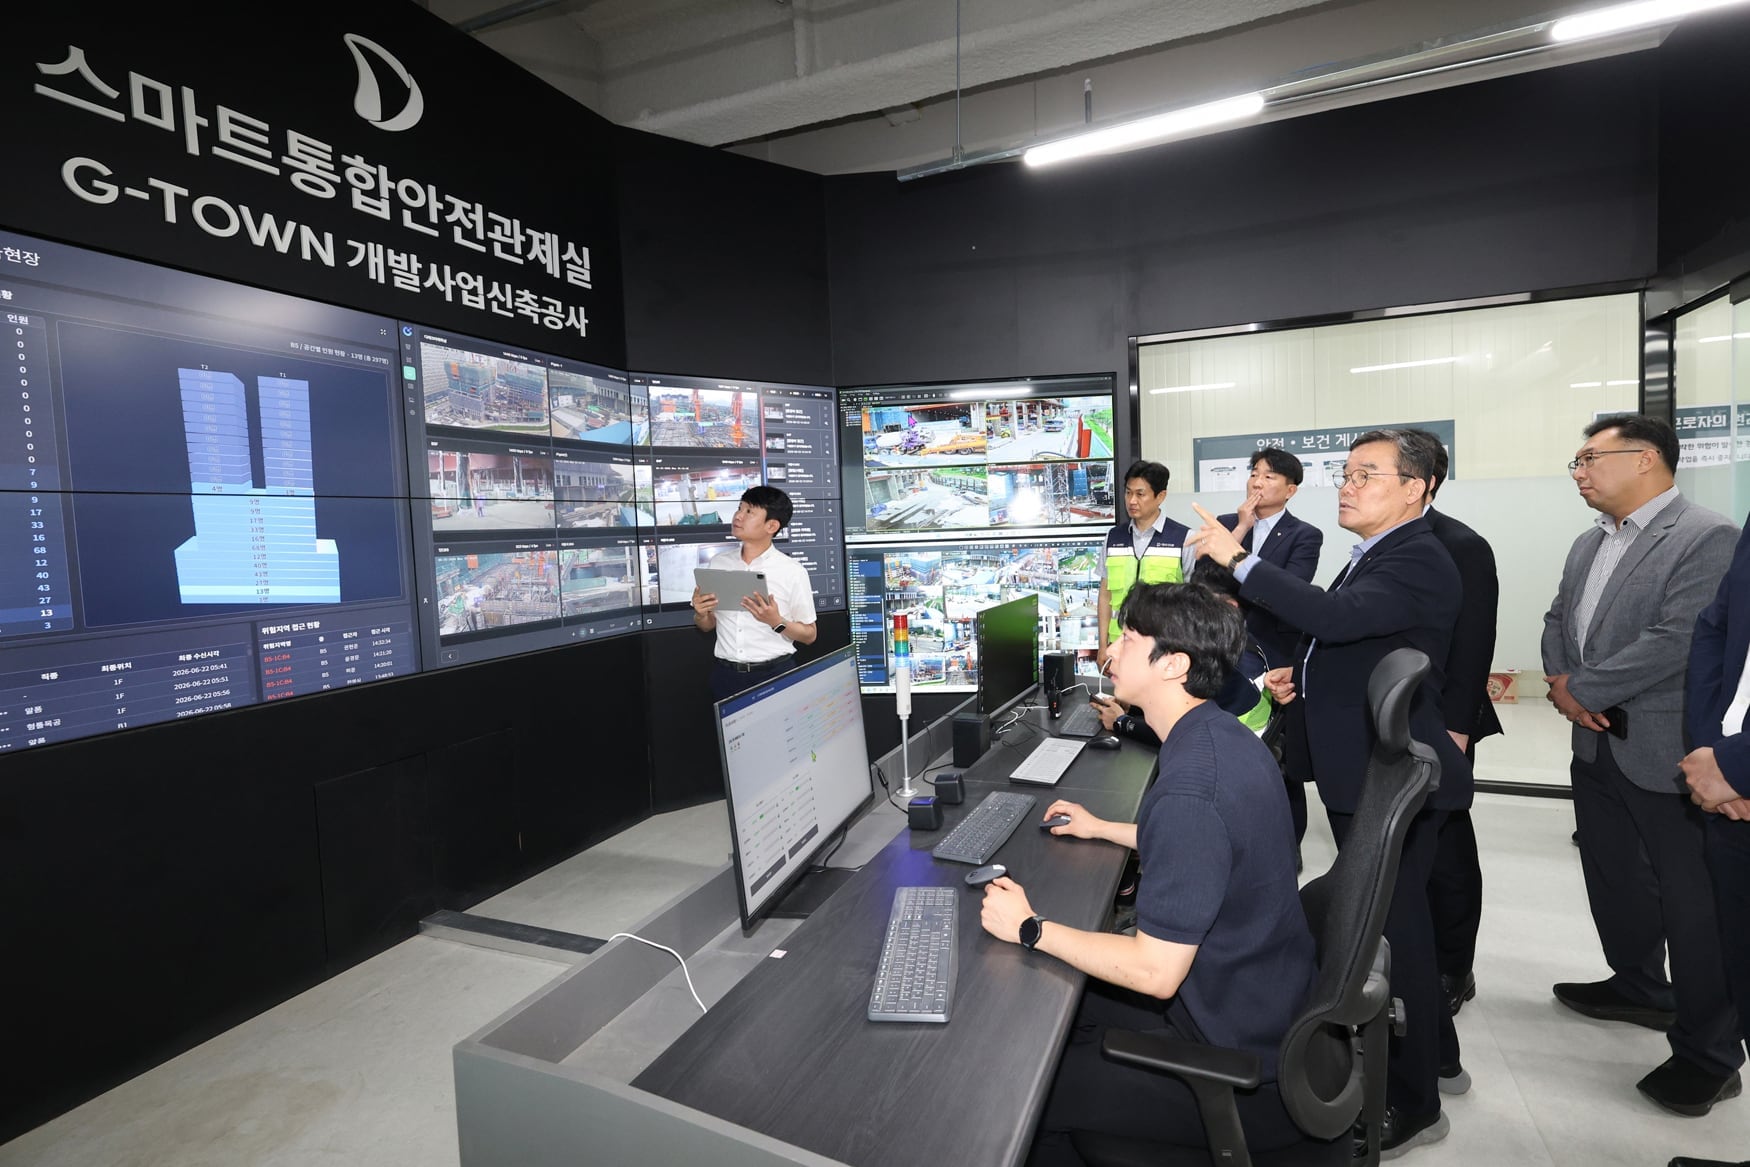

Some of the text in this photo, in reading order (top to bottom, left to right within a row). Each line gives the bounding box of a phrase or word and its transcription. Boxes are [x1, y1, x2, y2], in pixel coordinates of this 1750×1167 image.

[34, 45, 592, 289] 스마트통합안전관제실
[61, 156, 589, 338] G-TOWN 개발사업신축공사
[0, 247, 40, 267] 현장
[7, 314, 29, 325] 인원
[1302, 434, 1330, 449] 보건
[29, 468, 36, 476] 7
[30, 481, 38, 489] 9
[31, 496, 38, 504] 9
[31, 521, 44, 529] 33
[35, 559, 48, 567] 12
[40, 609, 53, 617] 13
[172, 665, 209, 677] 2026-06-22
[210, 663, 227, 672] 05:41
[174, 679, 211, 690] 2026-06-22
[211, 676, 229, 685] 05:51
[175, 692, 212, 704] 2026-06-22
